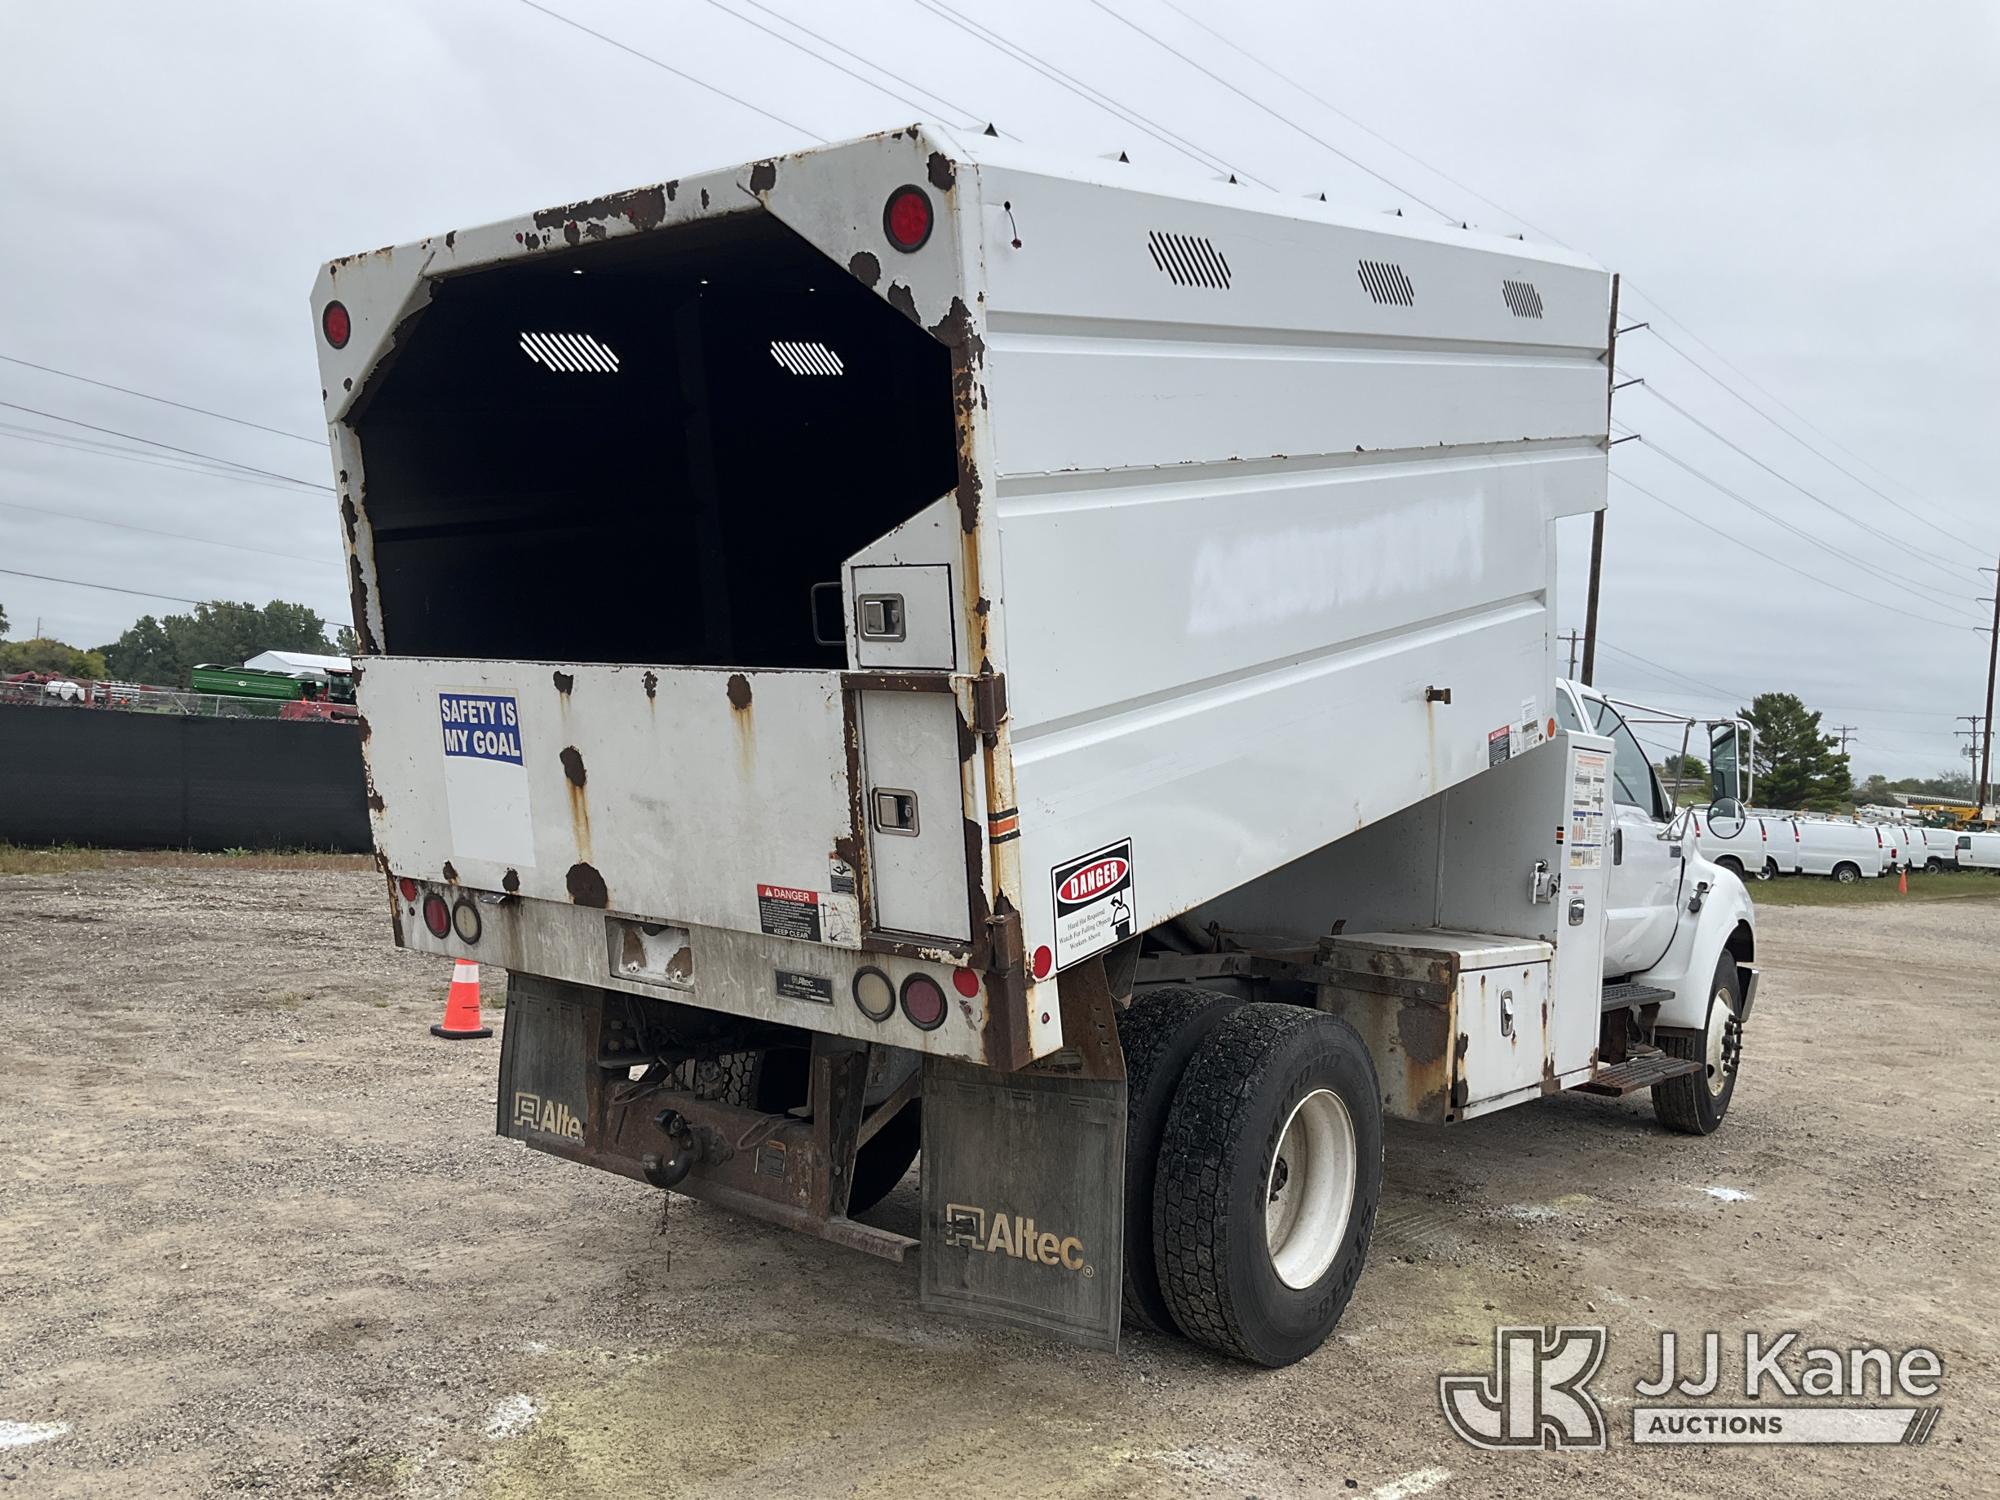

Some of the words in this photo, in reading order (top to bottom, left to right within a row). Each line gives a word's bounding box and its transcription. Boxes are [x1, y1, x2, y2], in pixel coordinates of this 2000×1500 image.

[442, 699, 496, 724] SAFETY
[500, 702, 516, 726] IS
[444, 729, 468, 752] MY
[473, 730, 520, 757] GOAL
[1070, 861, 1118, 899] DANGER
[774, 888, 810, 902] DANGER
[773, 927, 788, 936] KEEP
[789, 930, 809, 939] CLEAR
[1067, 920, 1079, 931] Hard
[1073, 930, 1081, 939] For
[1081, 923, 1095, 935] Falling
[987, 1212, 1084, 1271] Altec
